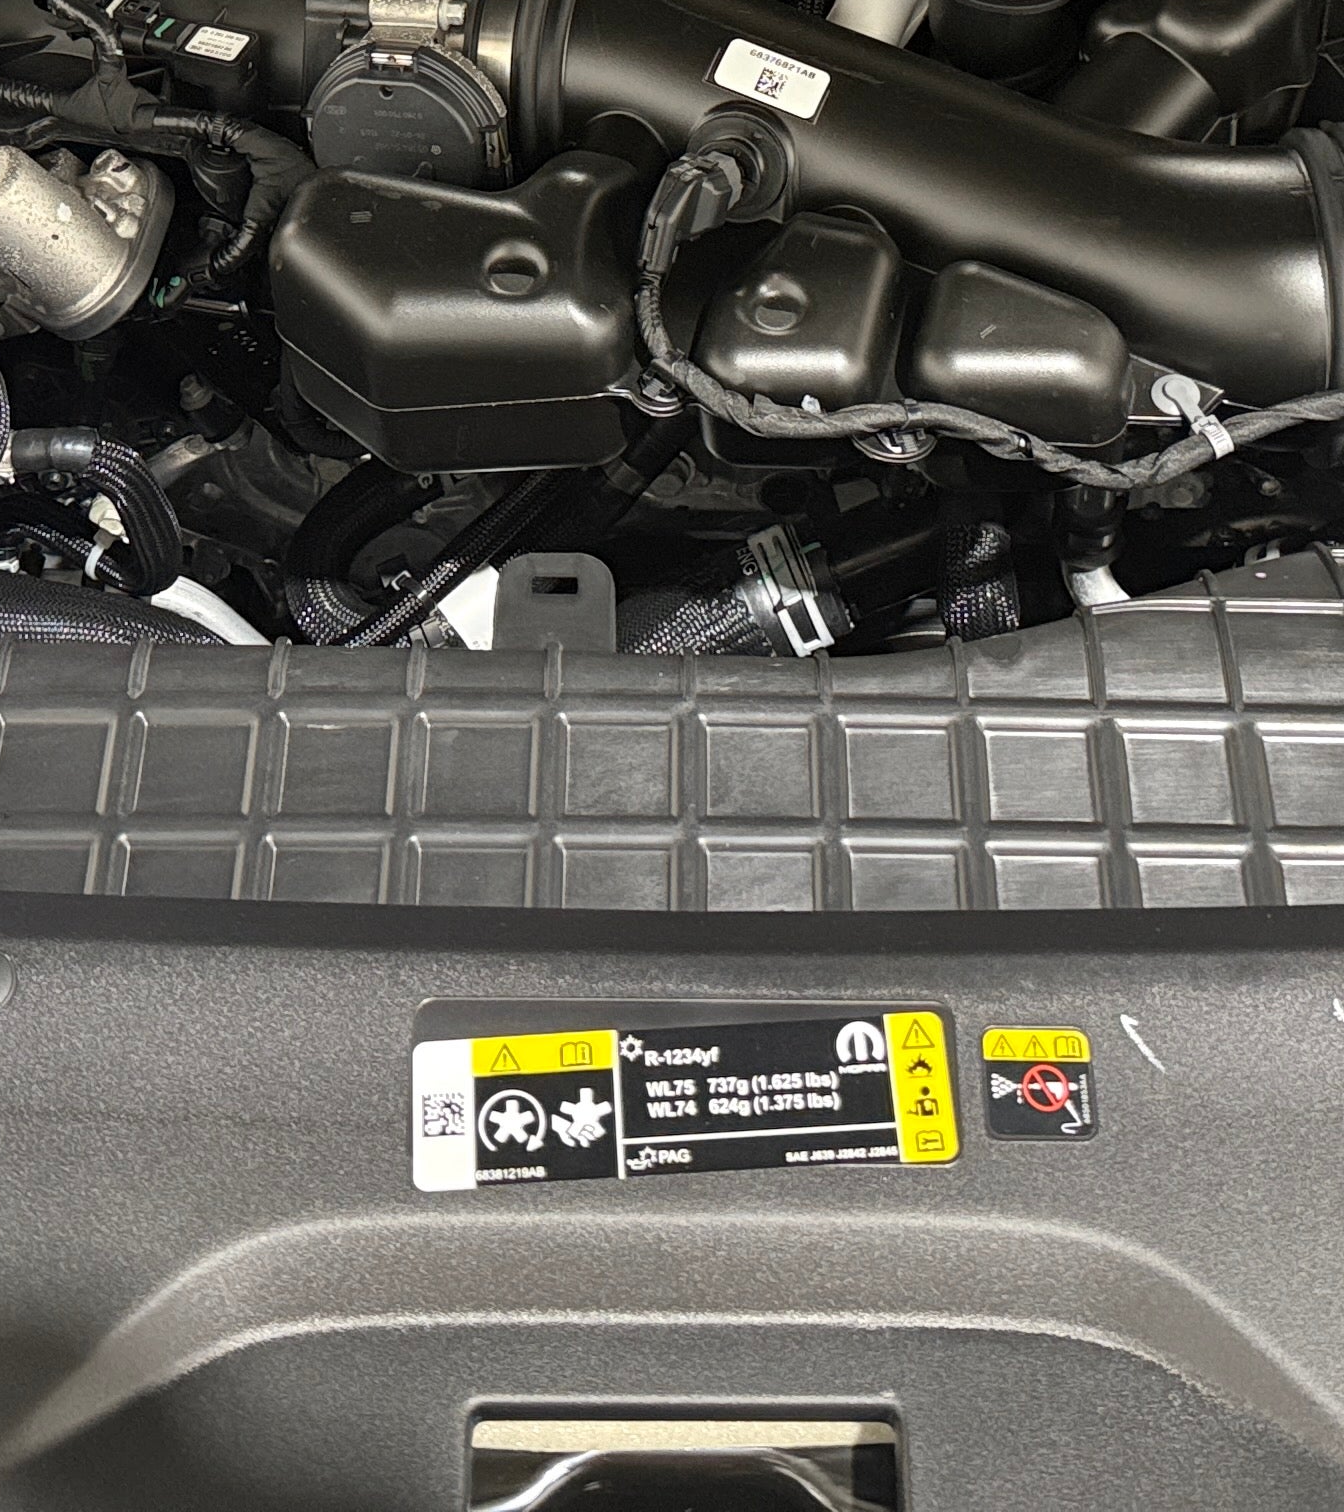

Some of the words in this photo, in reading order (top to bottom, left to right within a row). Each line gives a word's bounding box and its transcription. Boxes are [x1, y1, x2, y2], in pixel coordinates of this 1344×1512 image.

[736, 547, 758, 576] ENG
[645, 1046, 720, 1067] R-1234yf
[838, 1063, 887, 1074] MOPAR
[646, 1079, 697, 1097] WL75
[707, 1076, 751, 1095] 737g
[751, 1072, 803, 1093] (1.625
[805, 1070, 840, 1090] lbs)
[647, 1100, 698, 1119] WL74
[709, 1097, 752, 1116] 624g
[753, 1094, 805, 1115] (1.375
[806, 1091, 842, 1111] lbs)
[658, 1148, 692, 1164] PAG
[785, 1151, 809, 1163] SAE
[475, 1165, 546, 1182] 68381219AB
